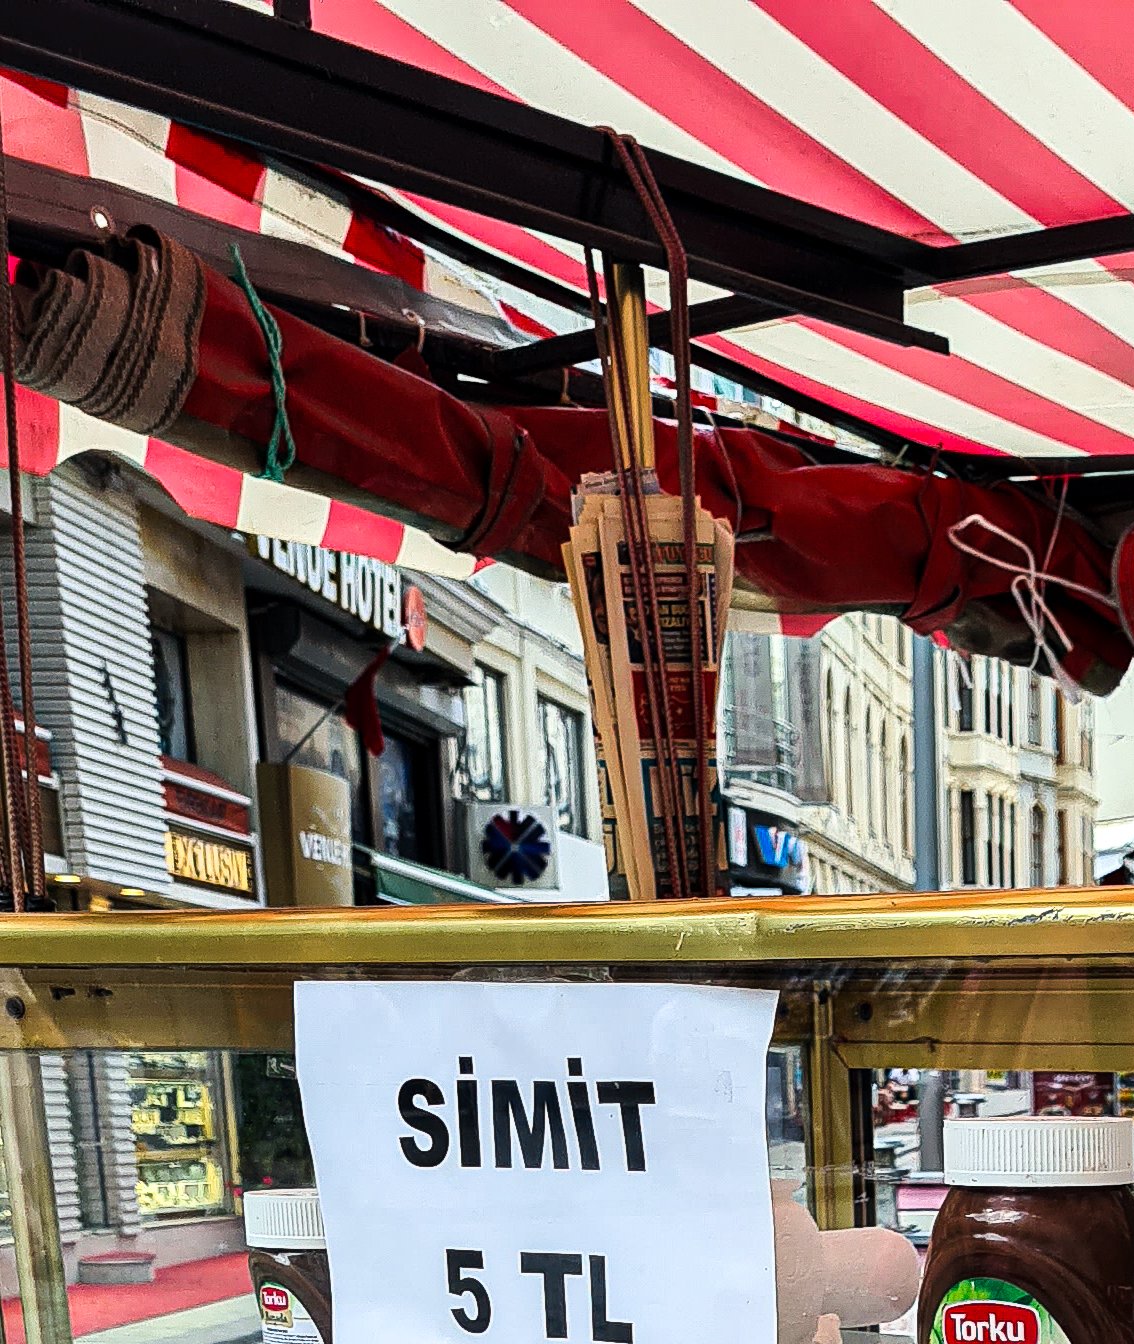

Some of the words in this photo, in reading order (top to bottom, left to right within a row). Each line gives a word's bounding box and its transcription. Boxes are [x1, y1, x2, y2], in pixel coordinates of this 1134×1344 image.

[398, 1056, 656, 1172] SİMİT
[446, 1249, 491, 1334] 5
[520, 1251, 633, 1344] TL
[950, 1312, 1025, 1342] Torku
